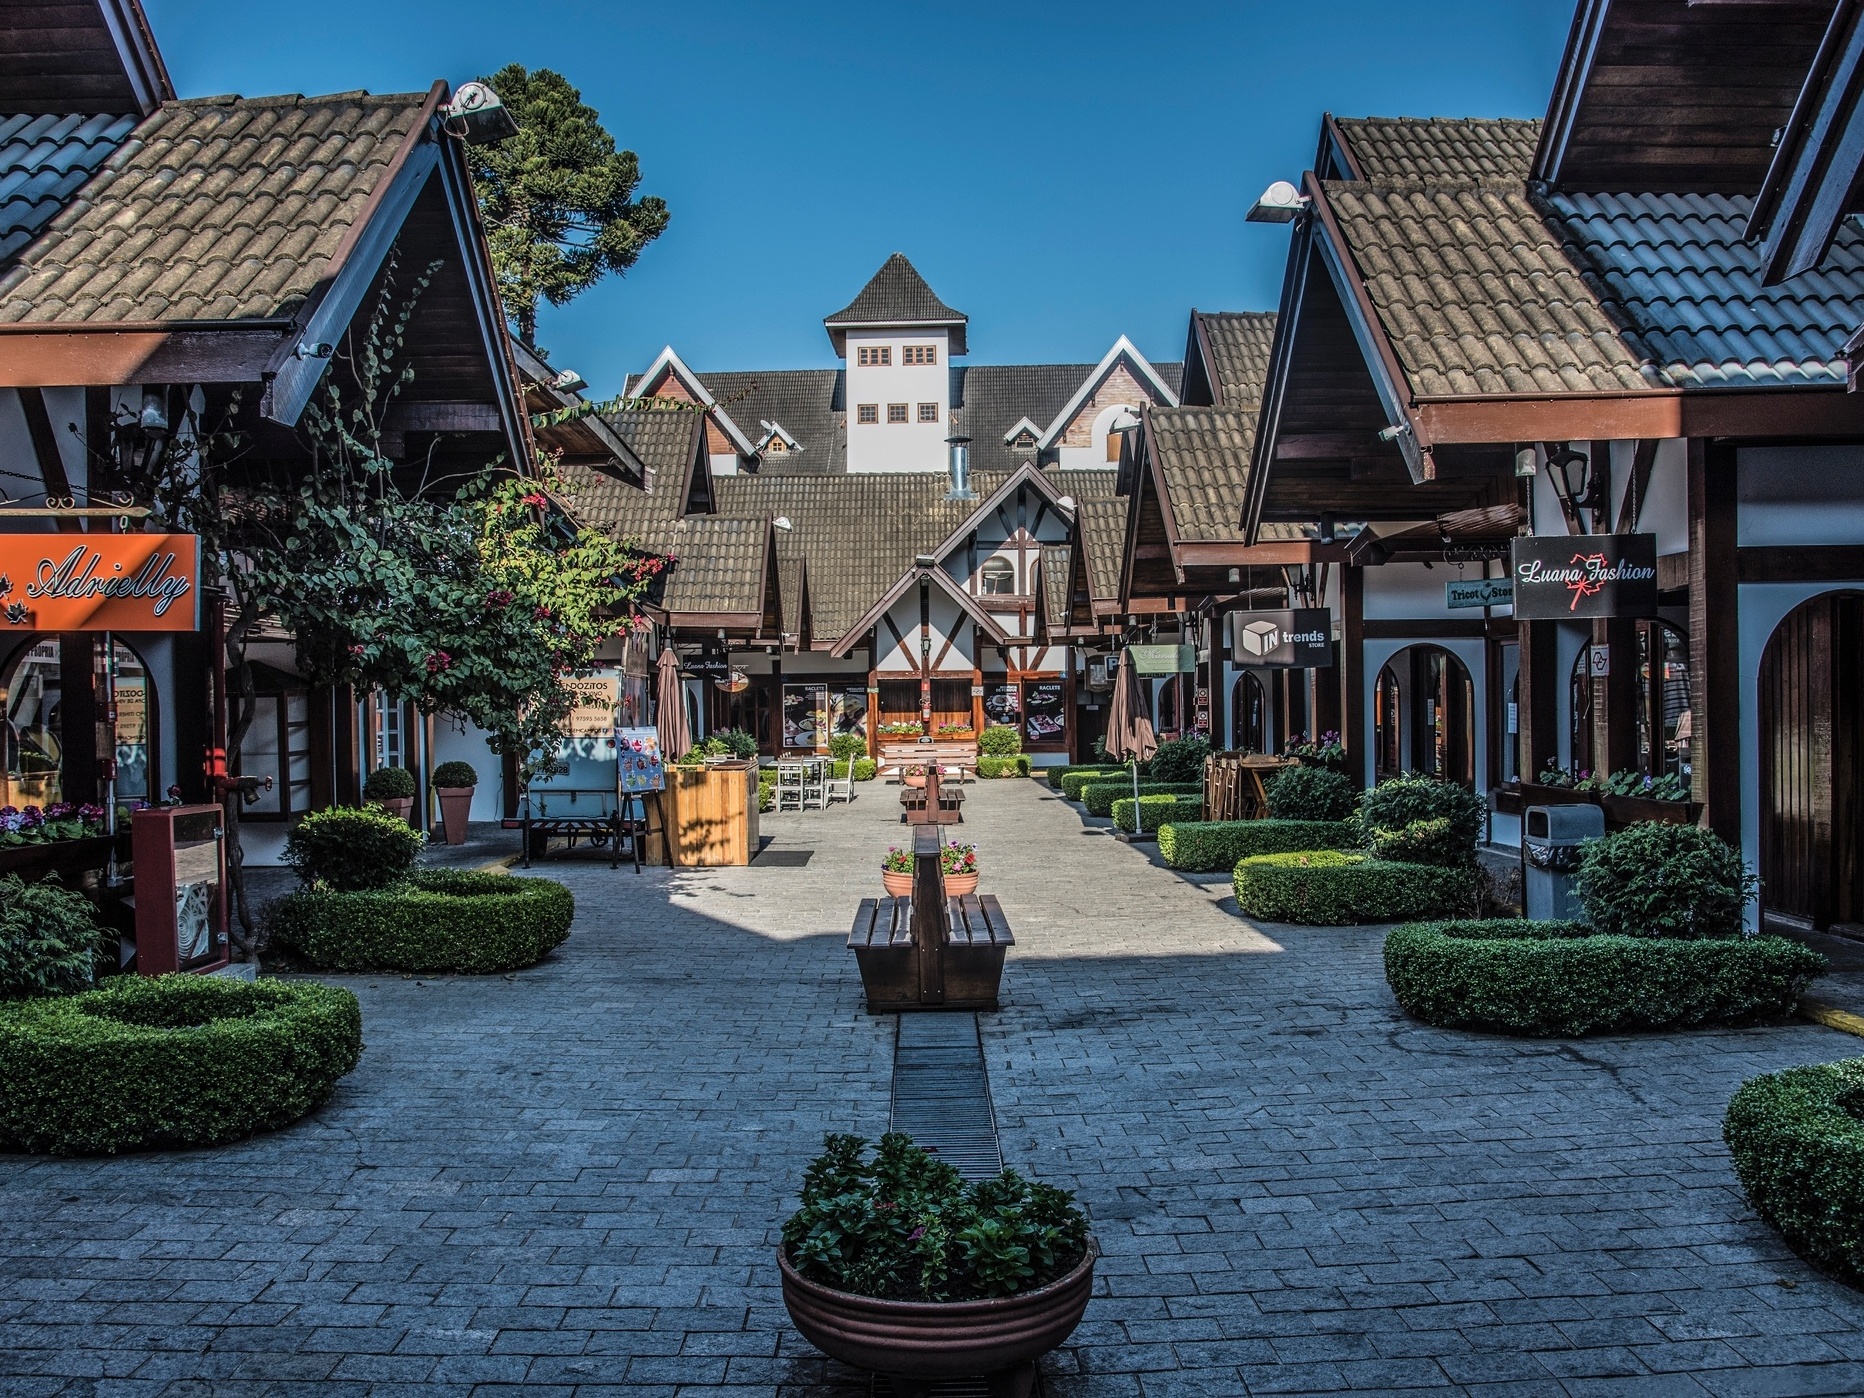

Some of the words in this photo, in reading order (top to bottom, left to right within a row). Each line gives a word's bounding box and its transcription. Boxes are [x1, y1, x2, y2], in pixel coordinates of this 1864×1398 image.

[1518, 560, 1583, 583] Luana
[1585, 558, 1655, 581] Fashion
[26, 544, 191, 616] Adrielly
[1451, 589, 1479, 600] Tricot
[1491, 587, 1513, 598] Stor
[1263, 630, 1278, 653] IN
[1282, 630, 1325, 643] trends
[683, 661, 705, 670] Luana
[705, 661, 728, 669] Fashion
[1108, 658, 1118, 671] P
